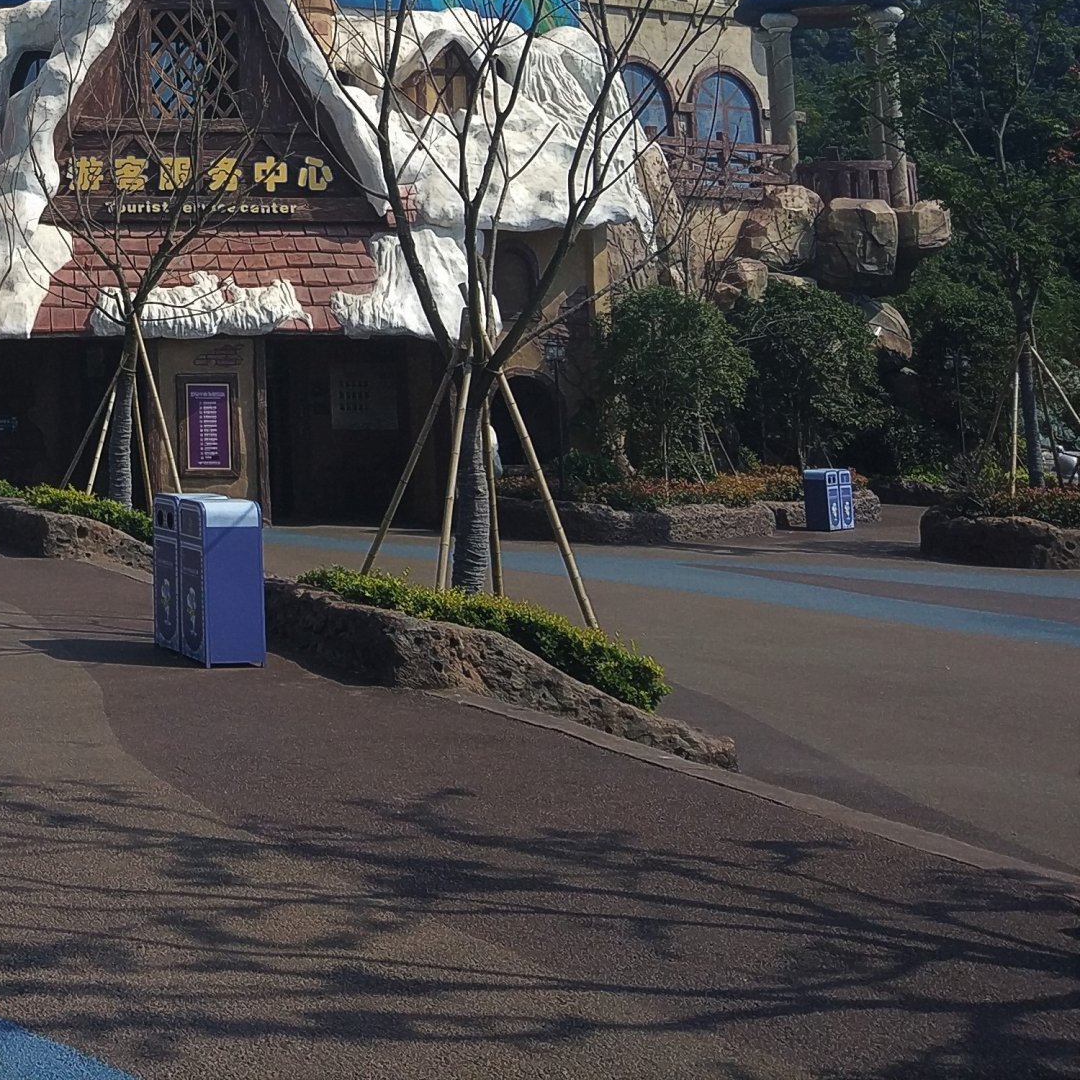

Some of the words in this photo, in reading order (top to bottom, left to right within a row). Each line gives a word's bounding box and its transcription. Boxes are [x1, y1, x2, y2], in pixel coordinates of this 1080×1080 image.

[66, 155, 334, 193] 游客服务中心
